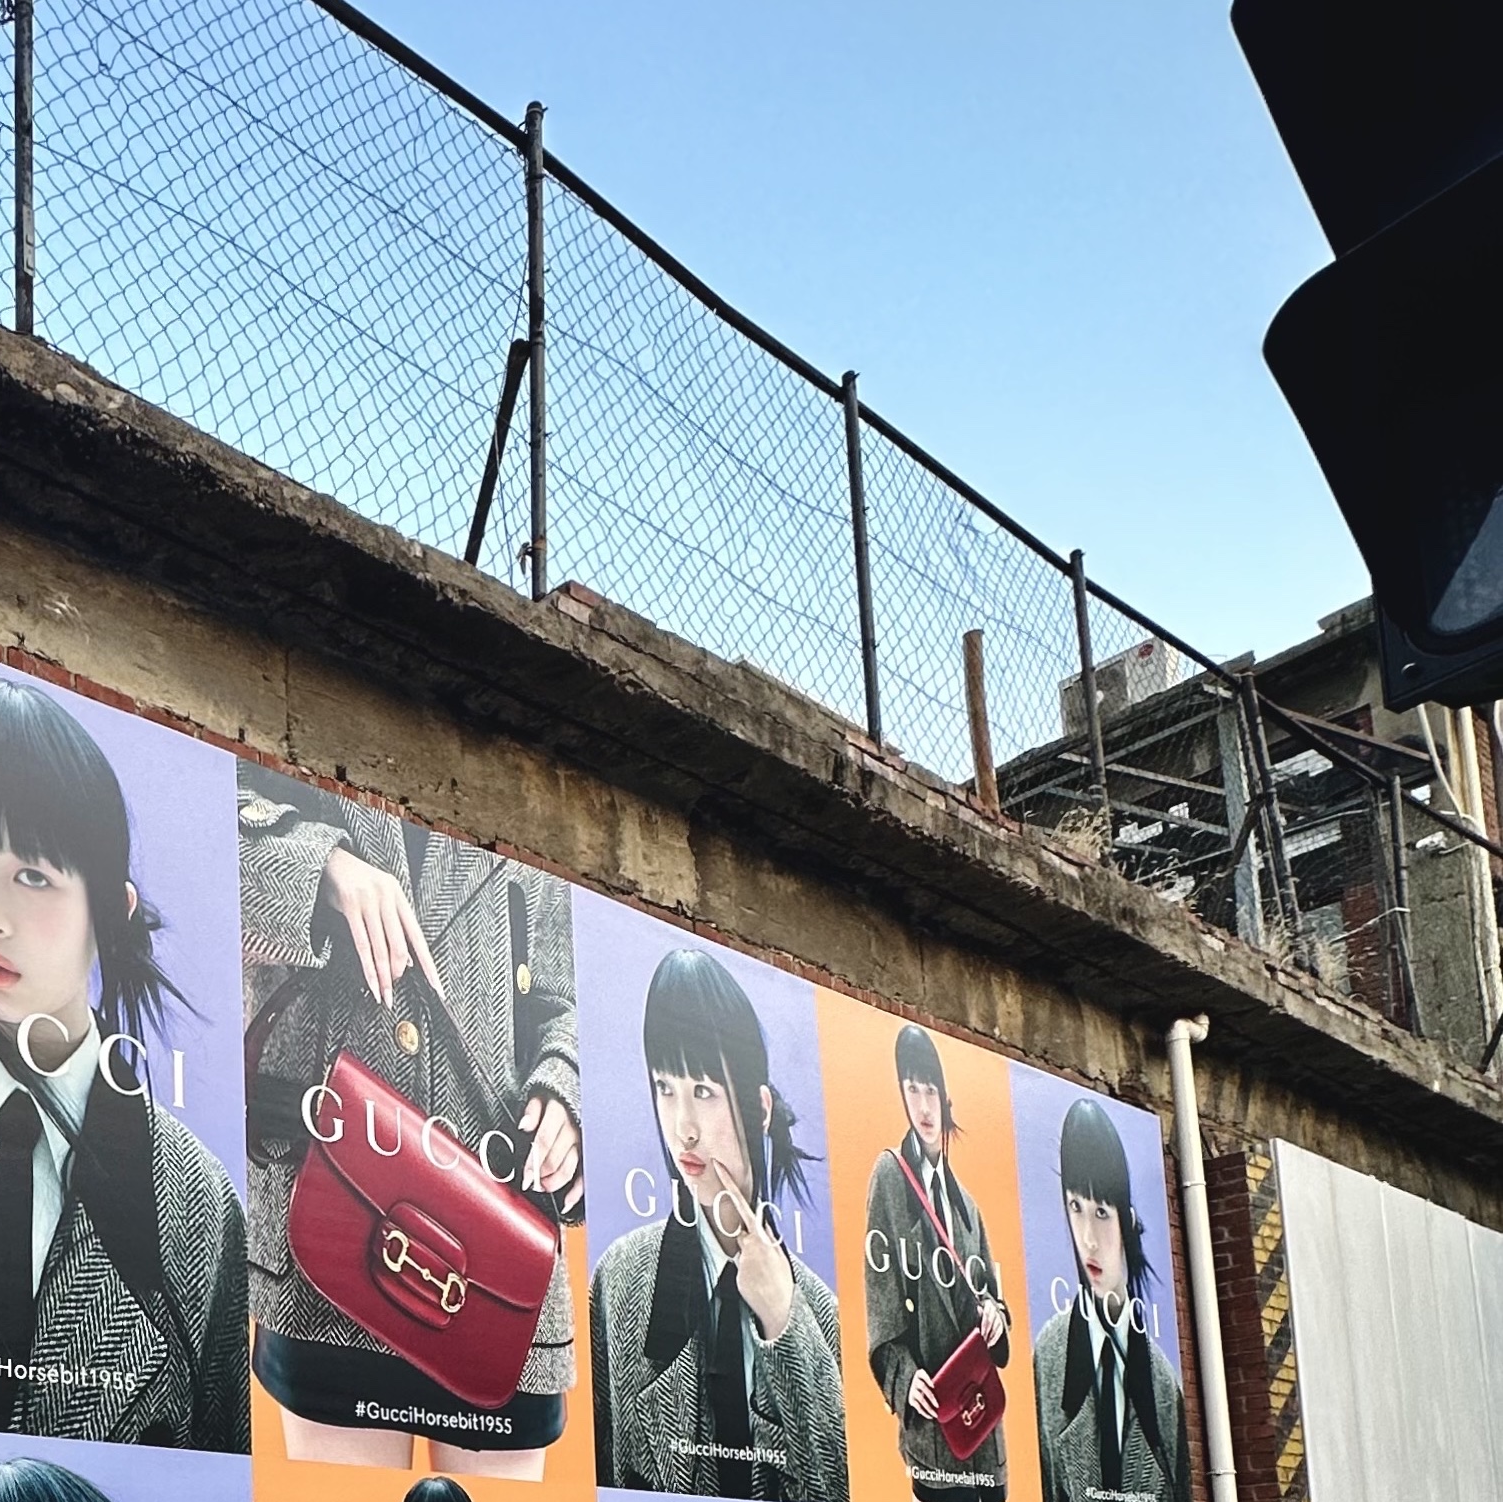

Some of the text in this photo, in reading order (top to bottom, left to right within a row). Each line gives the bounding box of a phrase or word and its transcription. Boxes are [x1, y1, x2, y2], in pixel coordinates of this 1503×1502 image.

[301, 1084, 547, 1193] GUCCI
[624, 1167, 804, 1255] GUCCI
[1050, 1276, 1161, 1338] GUCCI
[355, 1400, 513, 1435] #GucciHorsebit1955
[669, 1438, 787, 1465] #GucciHorsebit1955
[906, 1465, 996, 1488] #GucciHorsebit1955
